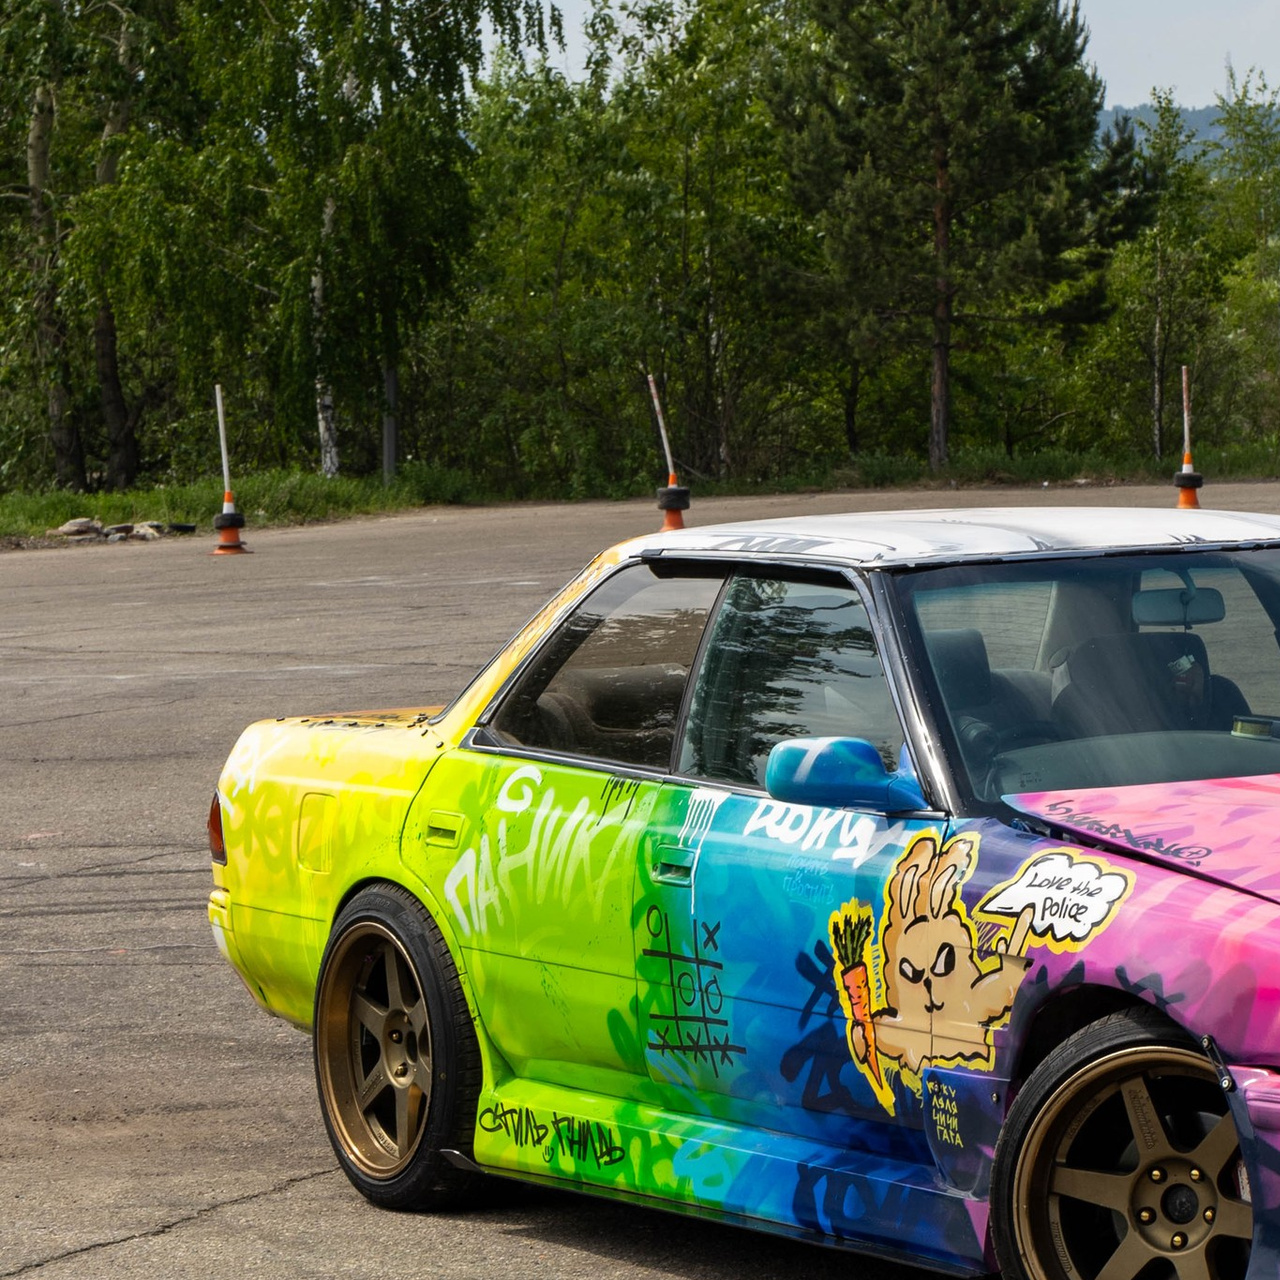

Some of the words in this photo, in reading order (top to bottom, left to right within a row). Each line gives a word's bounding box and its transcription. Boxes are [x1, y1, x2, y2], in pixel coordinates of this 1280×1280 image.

[1026, 872, 1073, 891] Love
[1071, 880, 1103, 898] the
[931, 1094, 958, 1115] ЛЯЛЯ
[479, 1102, 549, 1148] СТИЛЬ
[932, 1108, 958, 1132] ЧИЧИ
[936, 1125, 964, 1149] ГАГА
